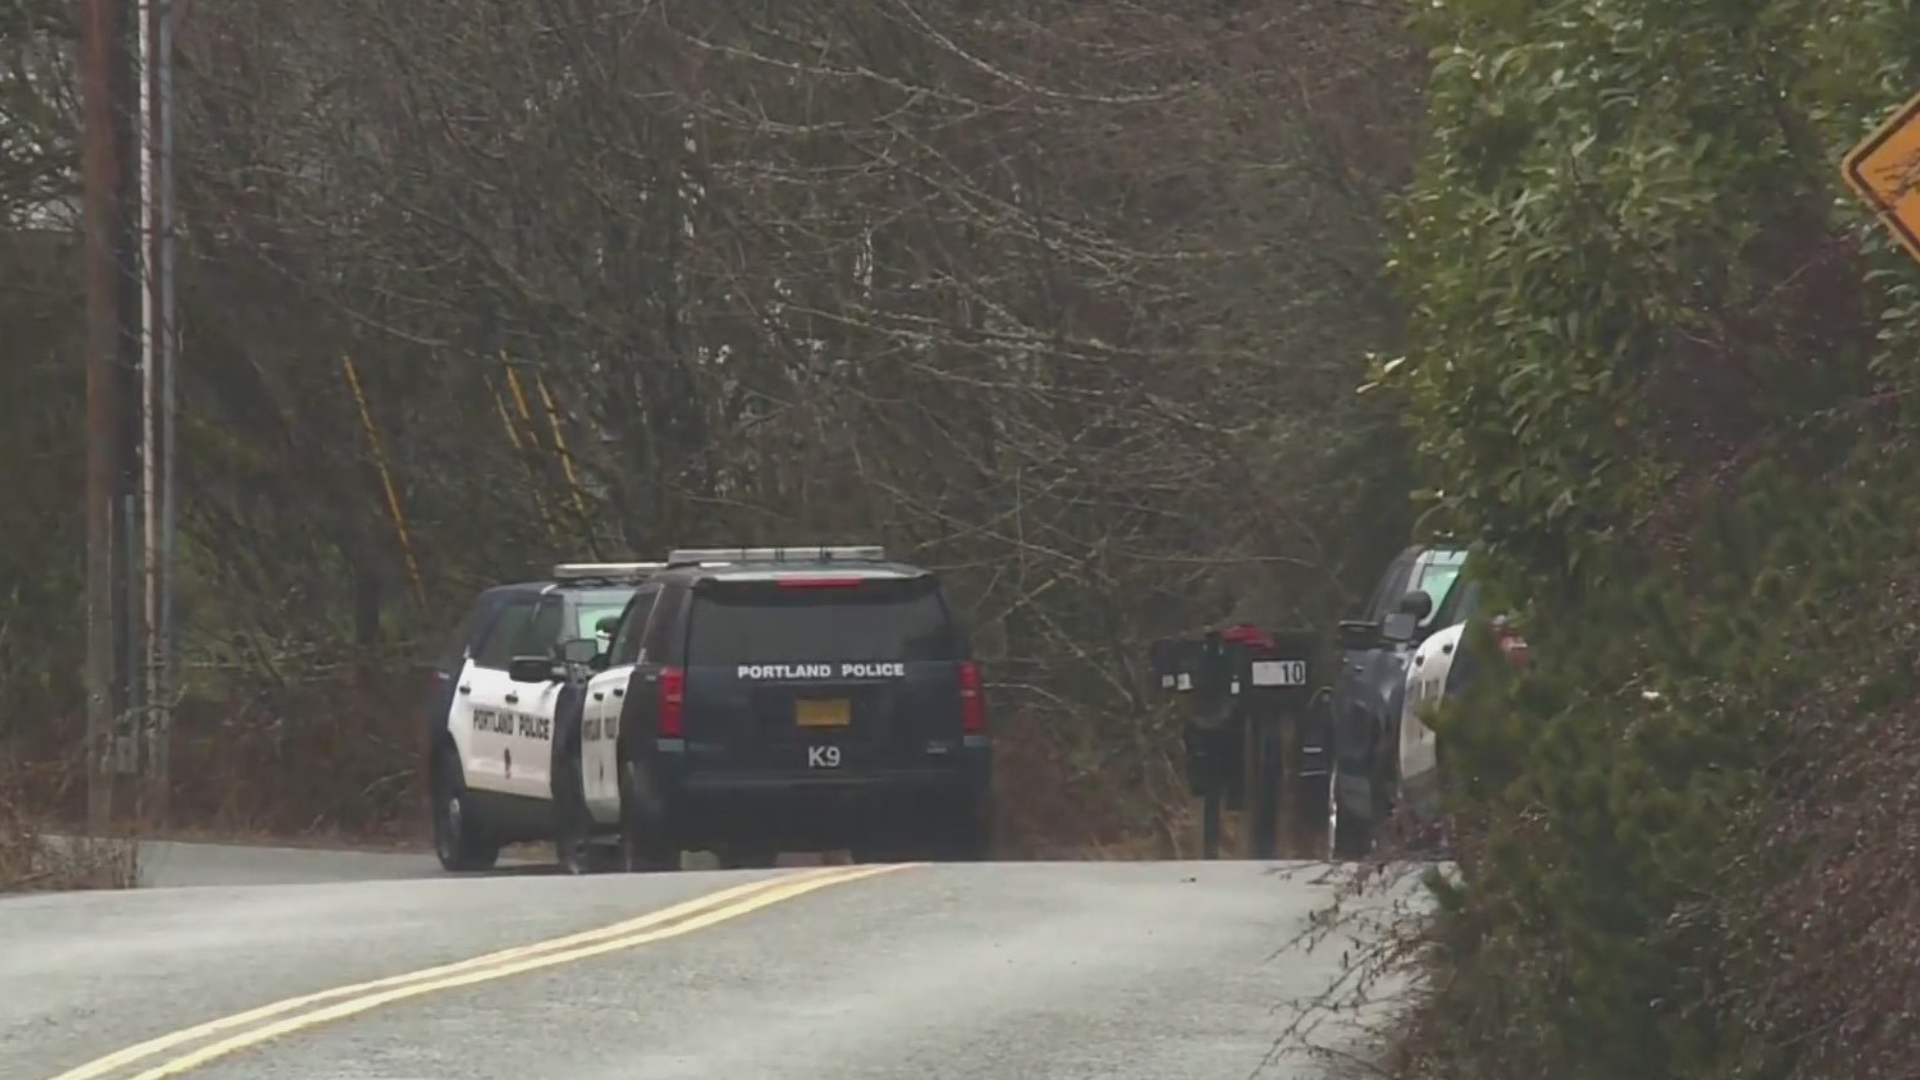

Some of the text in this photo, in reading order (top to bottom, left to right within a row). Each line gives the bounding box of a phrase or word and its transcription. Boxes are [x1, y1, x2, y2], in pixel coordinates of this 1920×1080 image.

[737, 663, 904, 679] PORTLAND POLICE
[1282, 662, 1305, 683] 10
[473, 709, 551, 740] PORTLAND POLICE
[808, 746, 841, 767] K9
